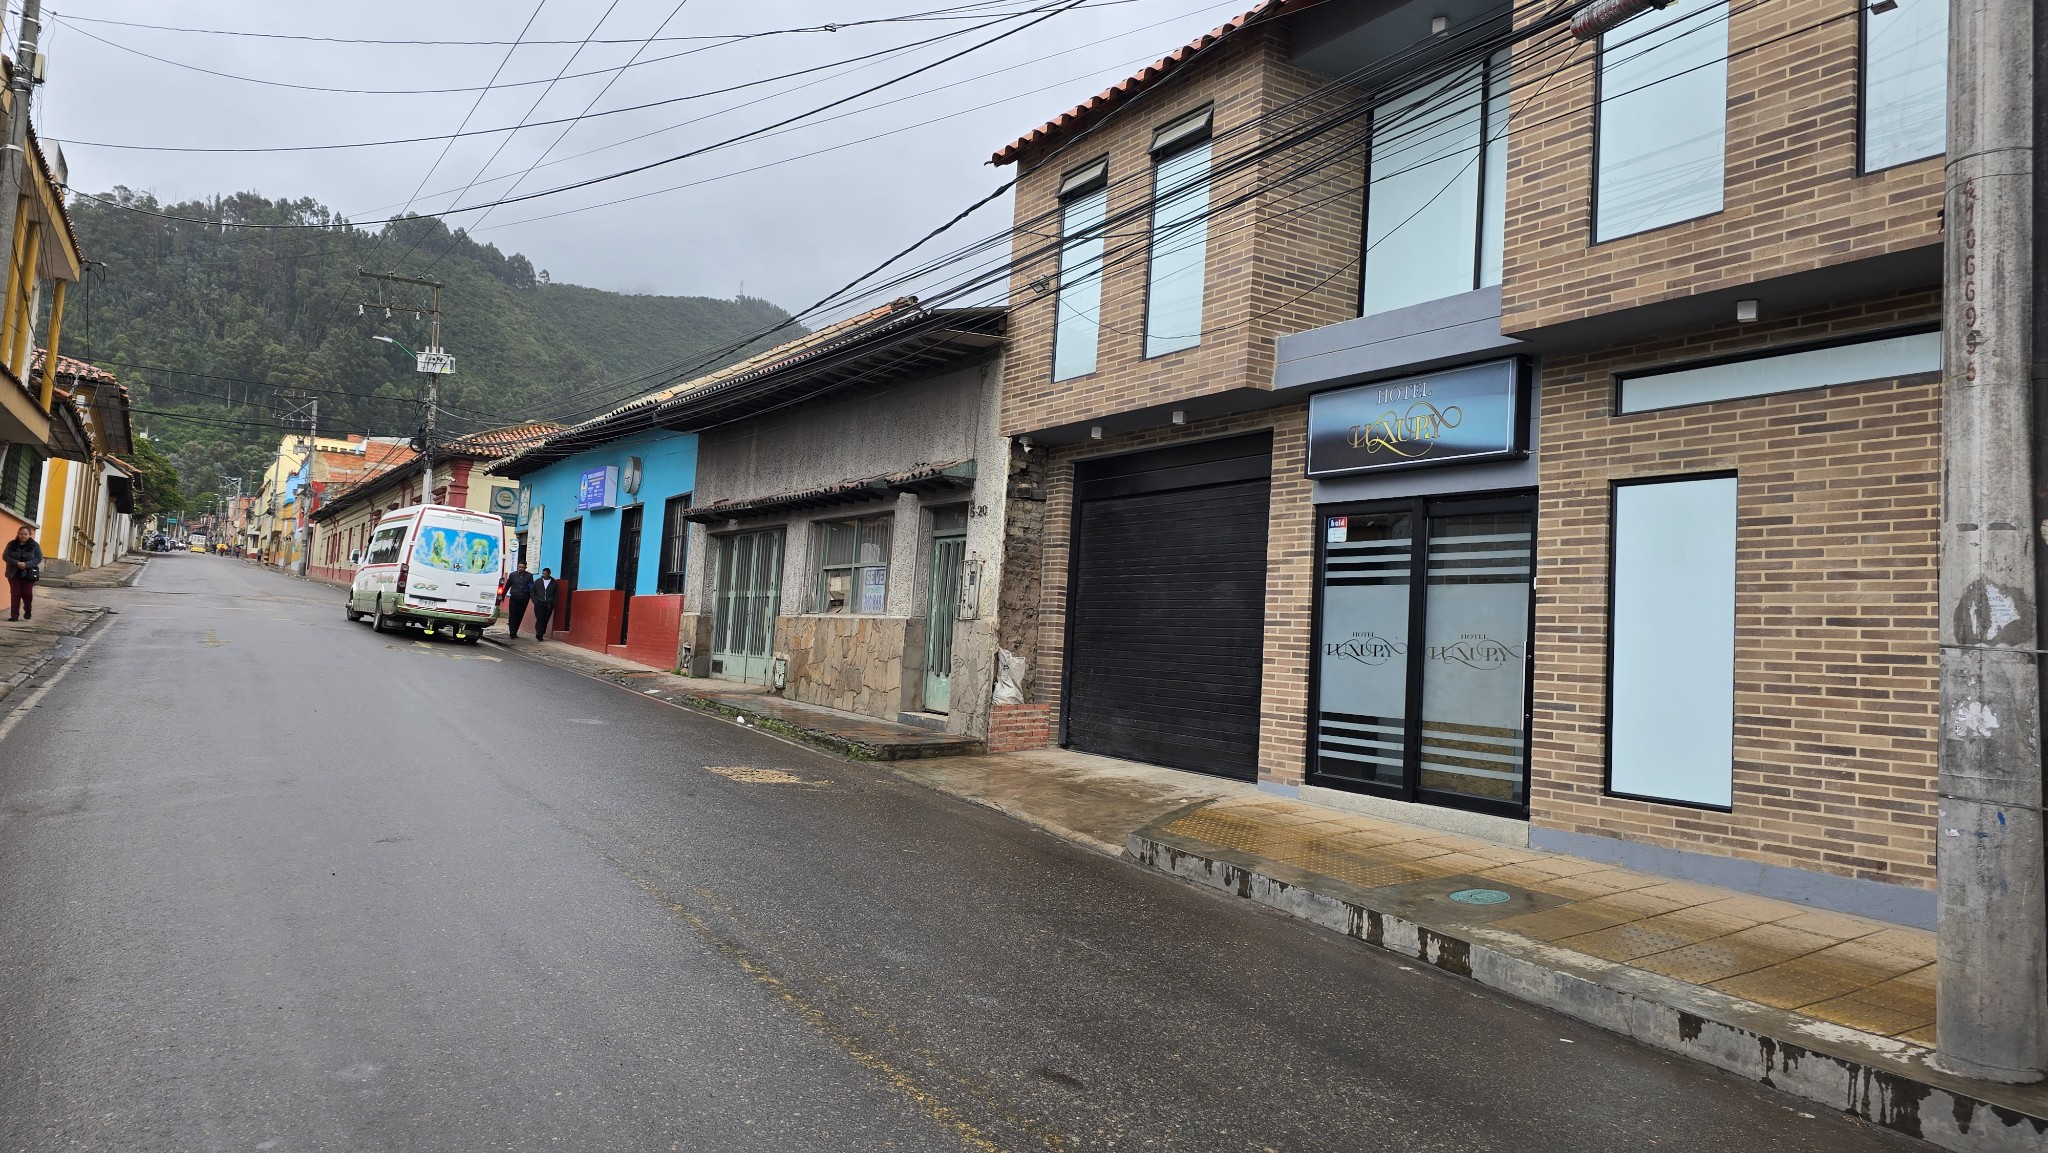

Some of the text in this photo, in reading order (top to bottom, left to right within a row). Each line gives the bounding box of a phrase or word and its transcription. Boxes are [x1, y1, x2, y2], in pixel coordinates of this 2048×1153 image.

[1376, 382, 1432, 404] HOTEL
[1346, 401, 1463, 458] LUXURY
[1322, 636, 1408, 666] LUXURY
[1425, 639, 1525, 671] LUXURY
